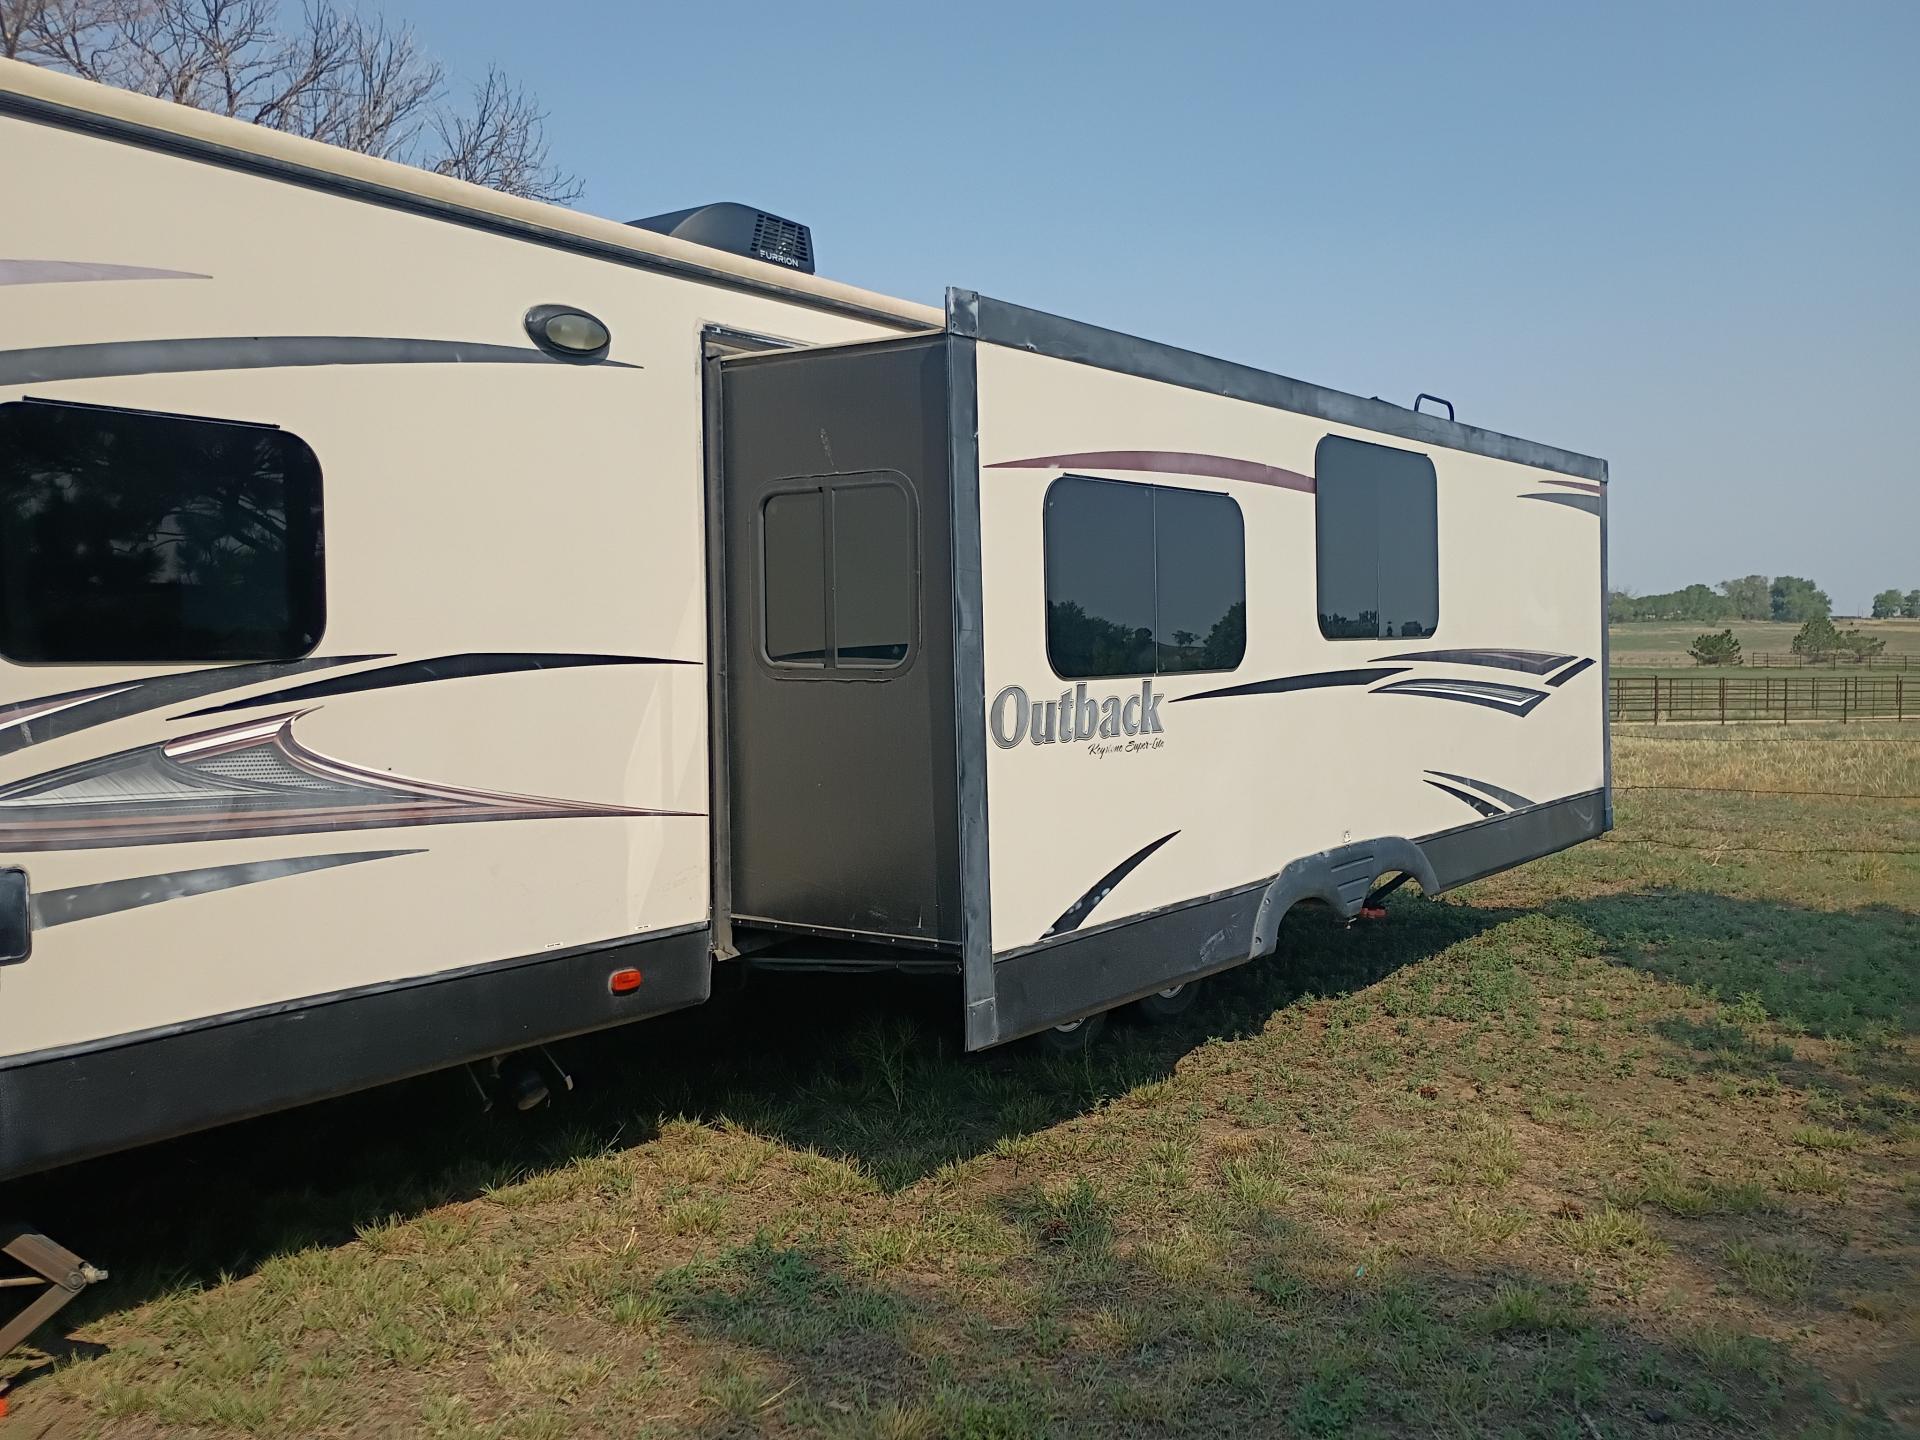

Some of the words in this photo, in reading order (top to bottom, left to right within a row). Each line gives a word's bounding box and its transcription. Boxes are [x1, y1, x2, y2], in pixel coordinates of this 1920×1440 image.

[759, 249, 799, 268] FURRION
[990, 678, 1165, 750] Outback
[1087, 743, 1123, 760] Keyne
